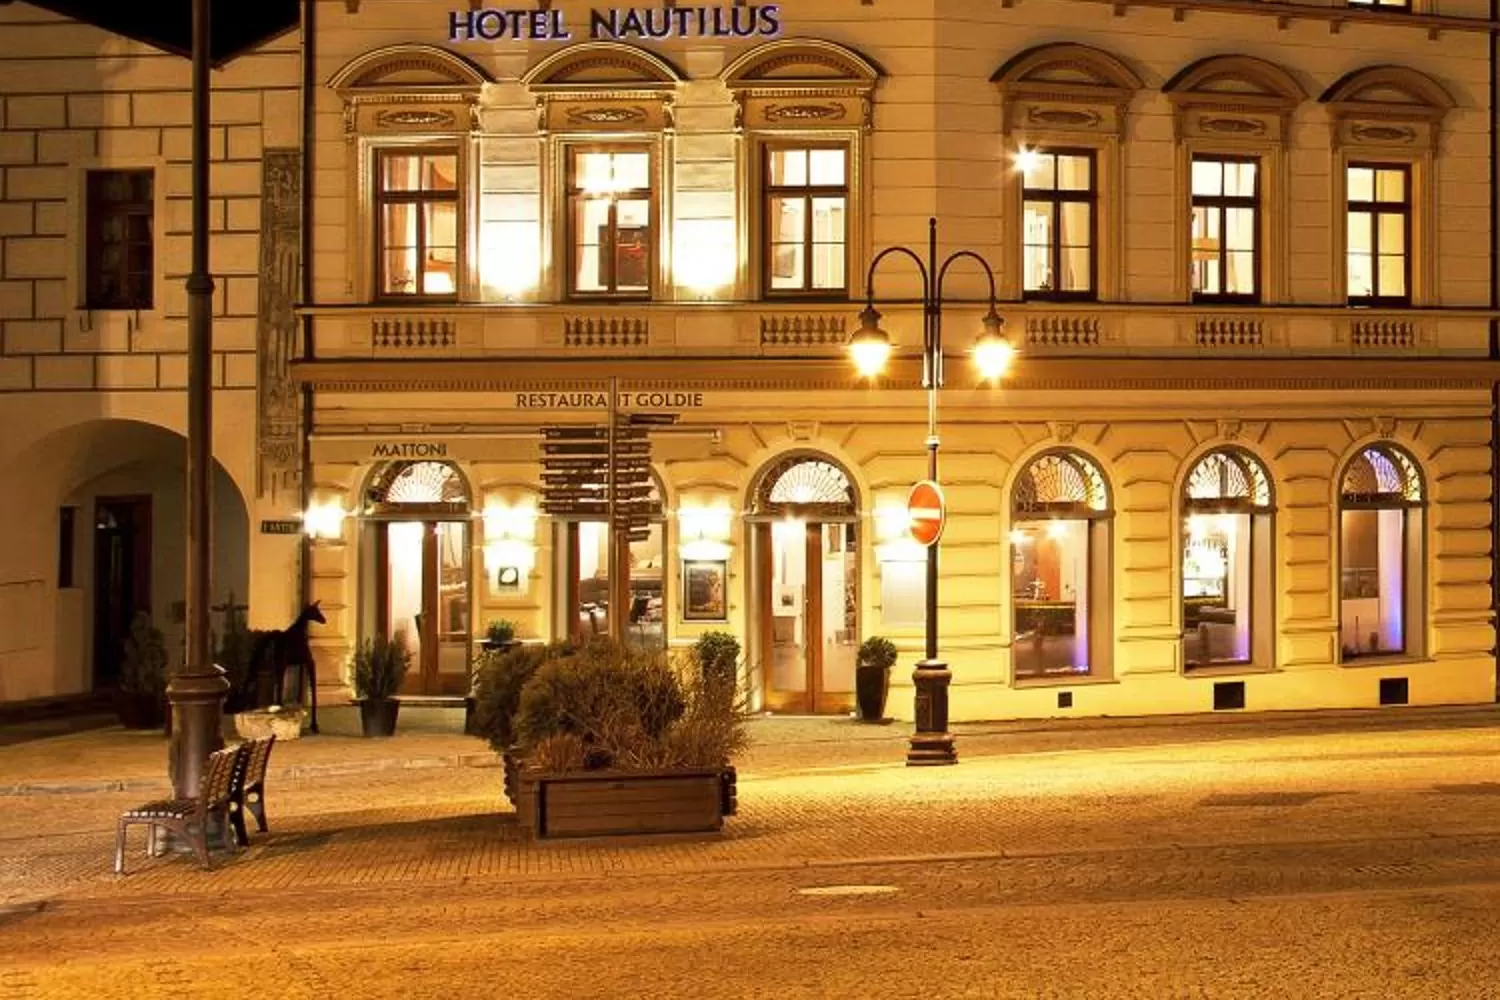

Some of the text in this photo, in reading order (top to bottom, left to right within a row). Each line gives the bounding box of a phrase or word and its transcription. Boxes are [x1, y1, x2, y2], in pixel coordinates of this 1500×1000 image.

[448, 5, 781, 41] HOTEL NAUTILUS
[516, 392, 703, 408] RESTAURAT GOLDIE
[372, 443, 447, 457] MATTONI
